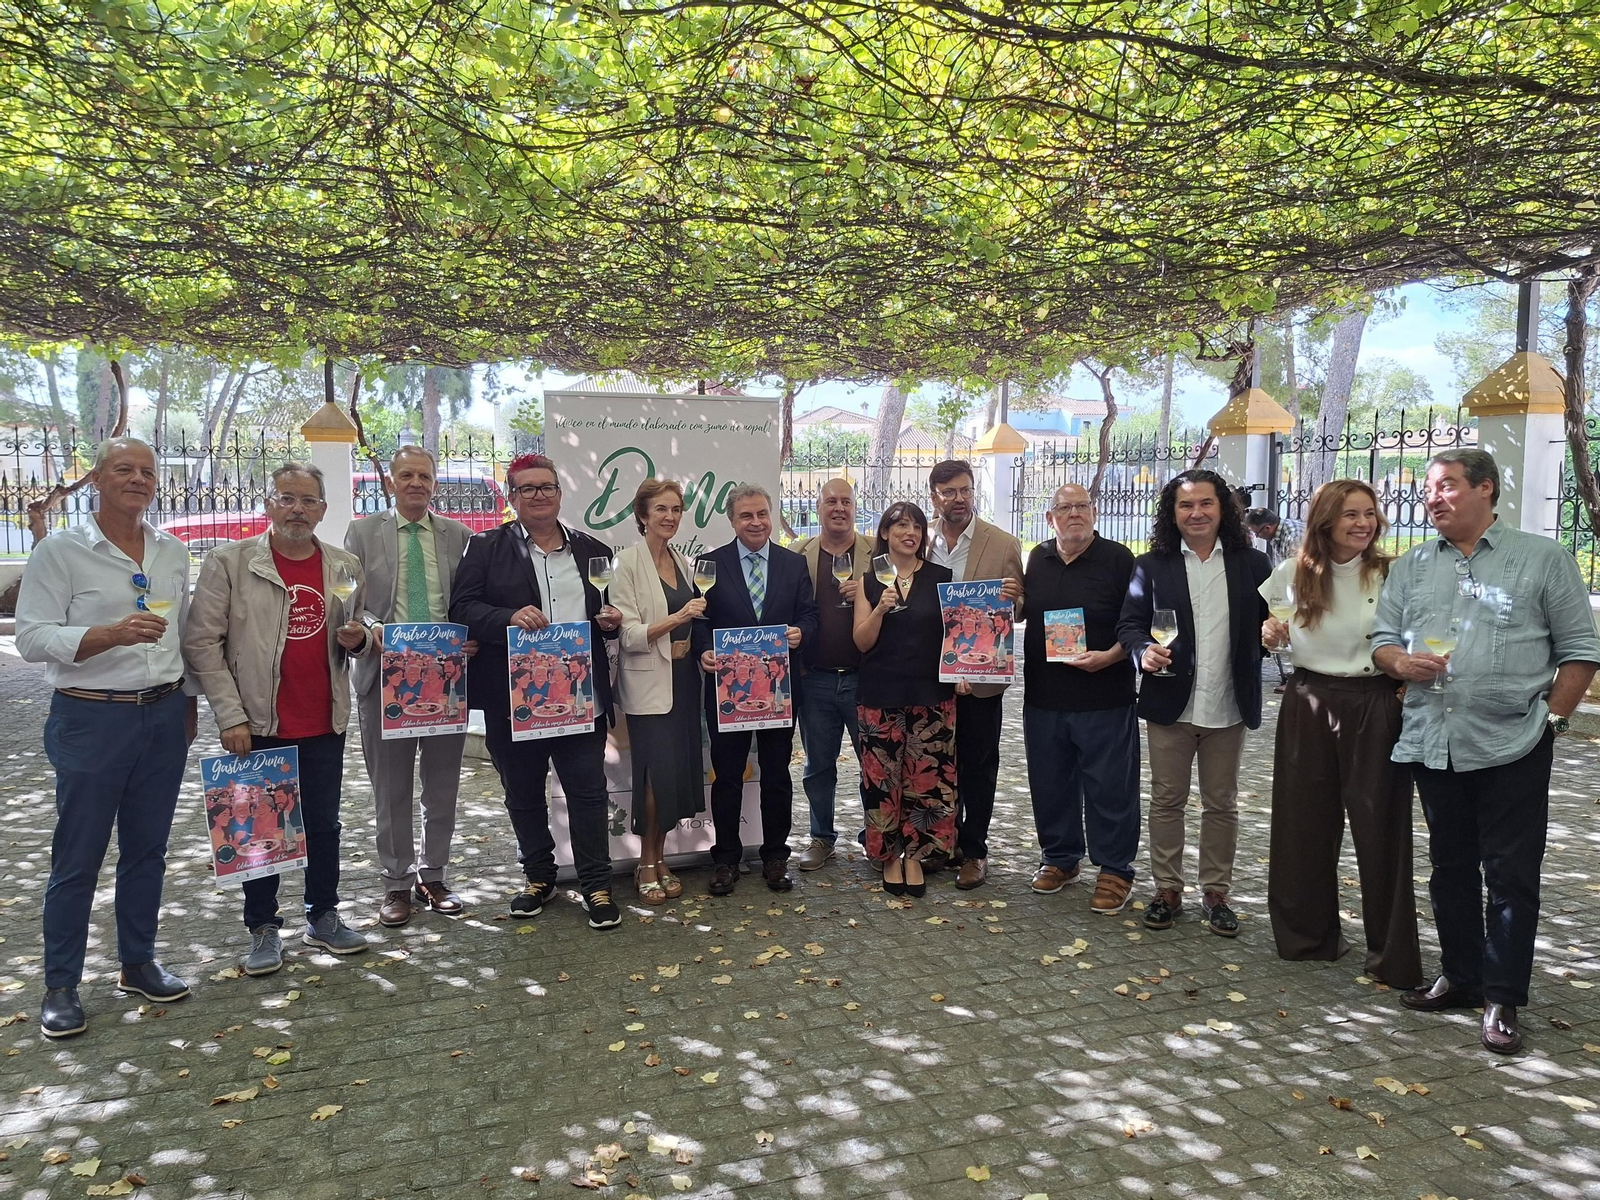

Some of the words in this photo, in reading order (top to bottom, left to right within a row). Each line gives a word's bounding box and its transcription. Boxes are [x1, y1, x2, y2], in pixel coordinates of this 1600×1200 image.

[585, 420, 595, 428] en
[597, 416, 608, 429] el
[609, 419, 638, 429] mundo
[641, 416, 686, 431] elaborado
[689, 422, 703, 430] con
[704, 422, 727, 433] zumo
[729, 420, 741, 431] de
[743, 420, 771, 435] nopal!
[946, 584, 977, 601] Gastro
[976, 582, 1003, 597] Duna
[391, 625, 428, 645] Gastro
[427, 625, 457, 641] Duna
[516, 628, 551, 648] Gastro
[552, 625, 580, 641] Duna
[721, 629, 753, 648] Gastro
[753, 629, 779, 644] Duna
[212, 756, 252, 781] Gastro
[252, 753, 286, 771] Duna
